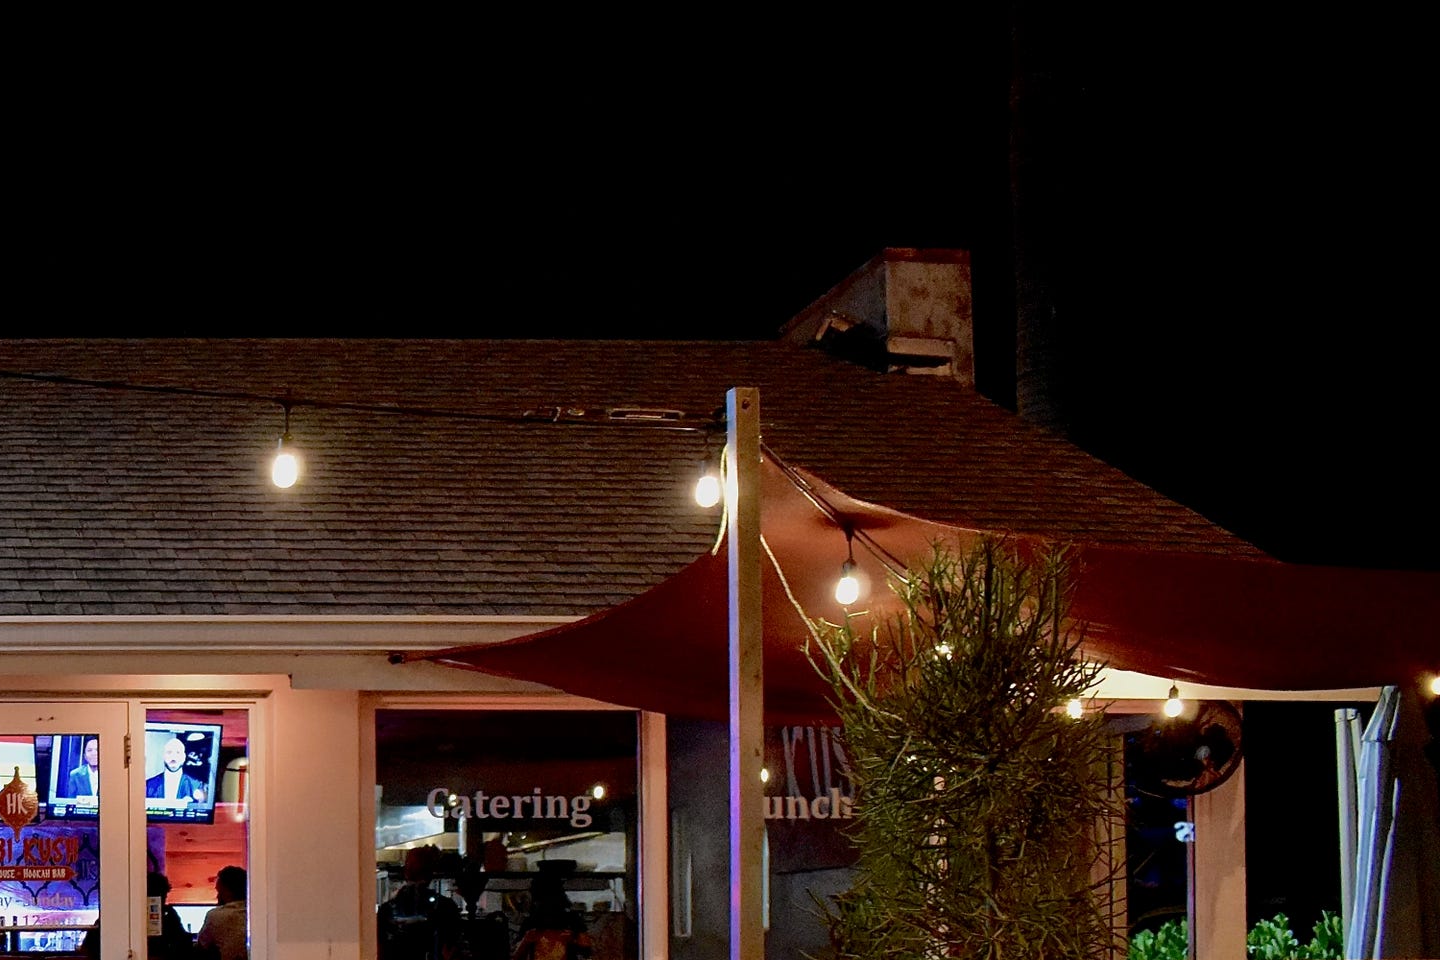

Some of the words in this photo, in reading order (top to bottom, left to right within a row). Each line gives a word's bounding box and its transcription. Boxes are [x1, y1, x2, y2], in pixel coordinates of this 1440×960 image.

[6, 792, 29, 815] HK
[426, 787, 594, 828] Catering
[762, 787, 854, 820] unch
[23, 836, 80, 864] KUSH
[23, 868, 51, 879] HOOKAH
